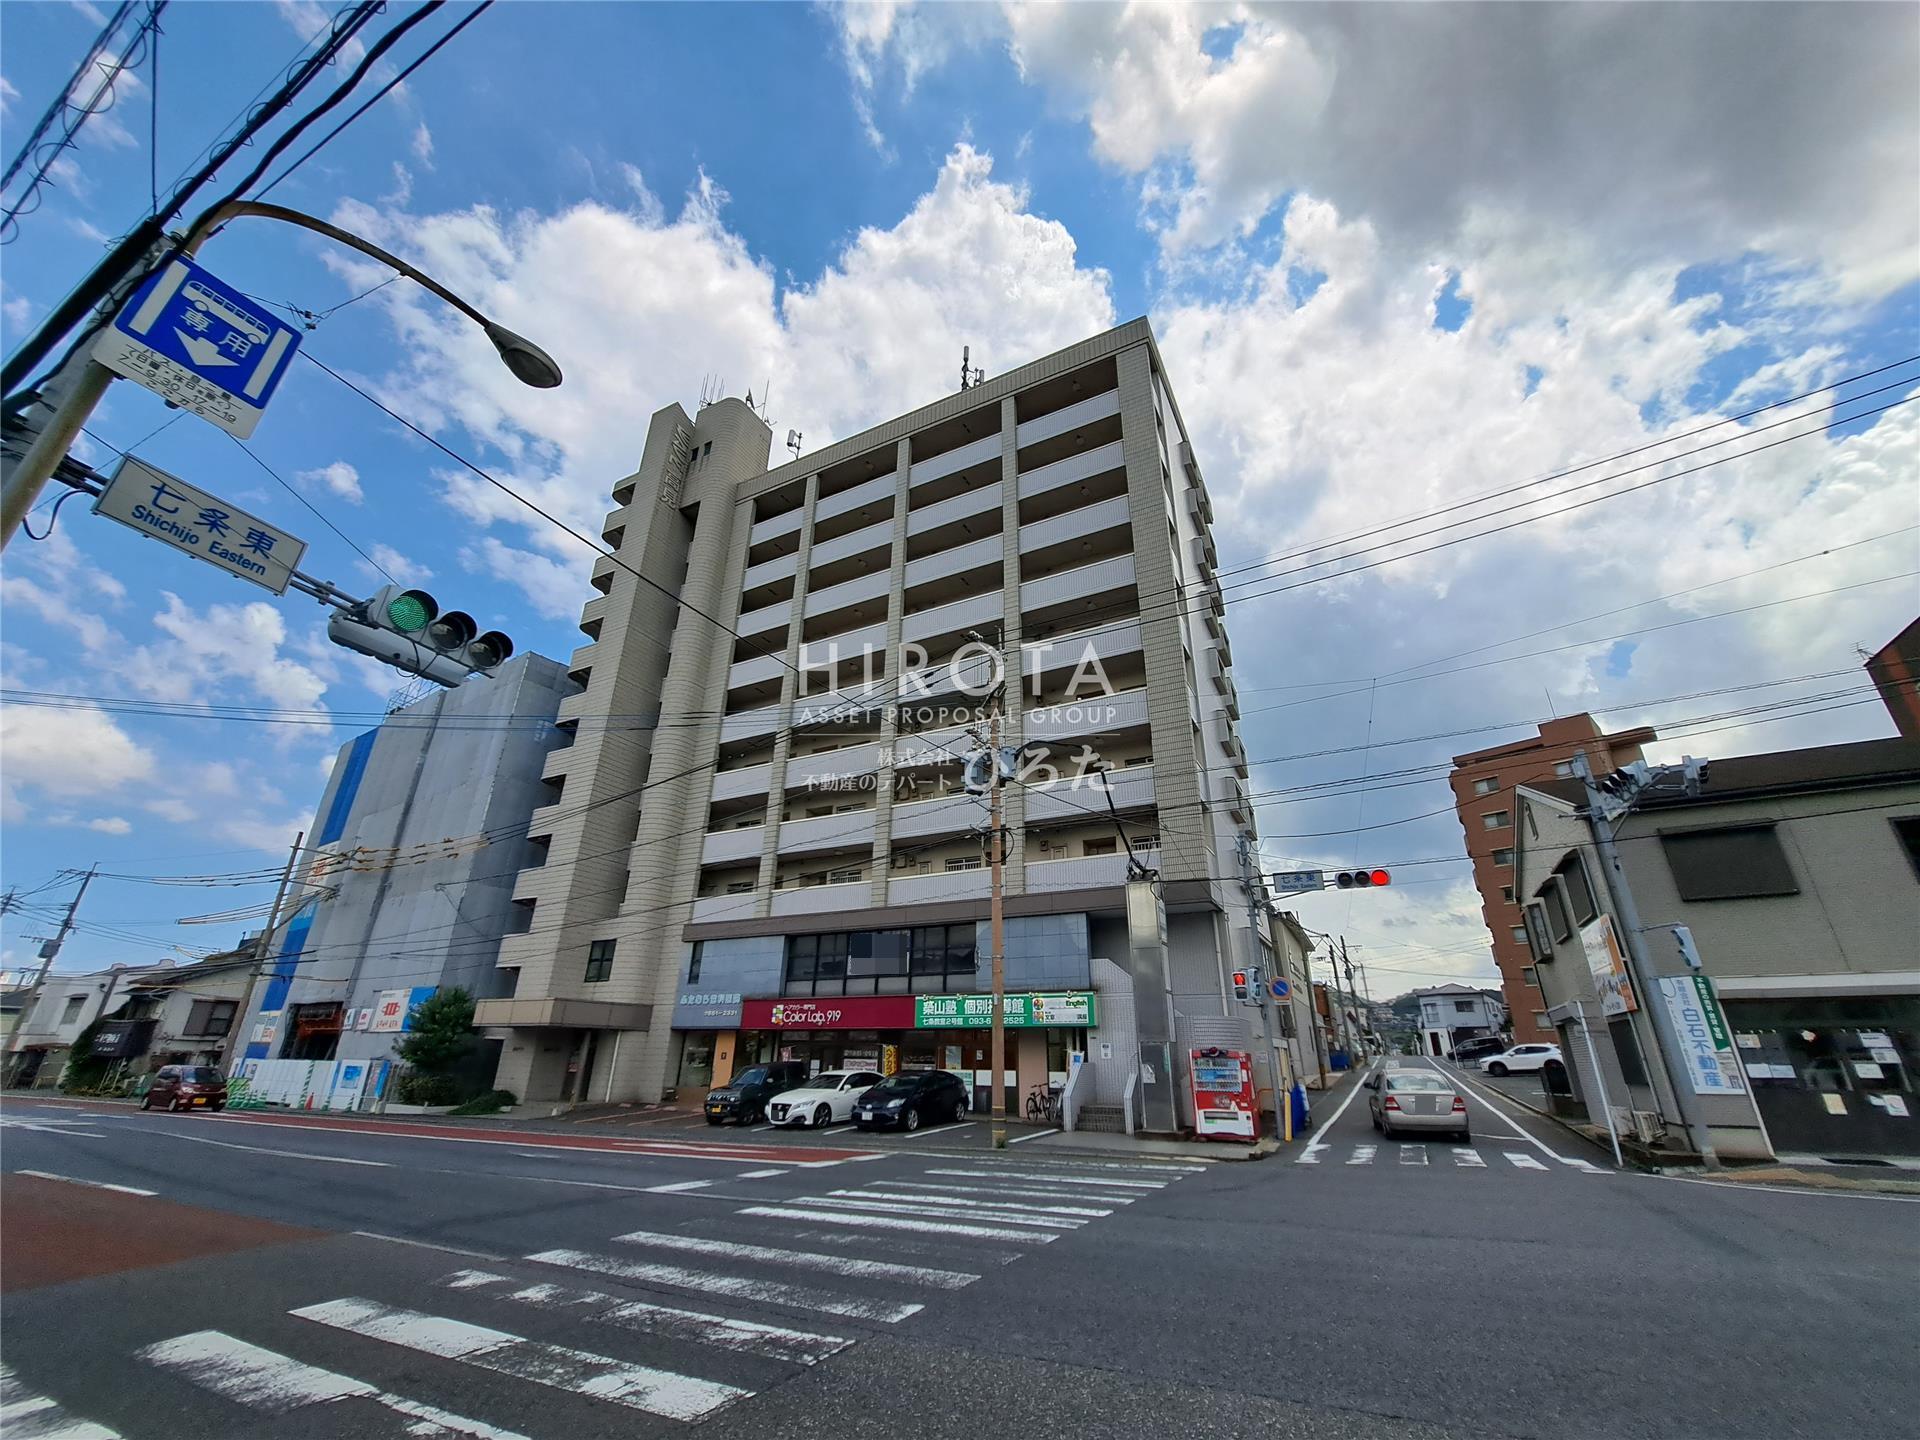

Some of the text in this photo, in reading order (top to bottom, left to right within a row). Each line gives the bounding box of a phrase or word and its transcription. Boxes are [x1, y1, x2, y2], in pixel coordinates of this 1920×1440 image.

[180, 306, 251, 358] 専用
[132, 504, 267, 576] Shichijo Eastern
[151, 482, 278, 559] 七条東
[784, 1010, 807, 1023] Color
[827, 1010, 841, 1022] 919
[1682, 1007, 1724, 1087] 白石不動産
